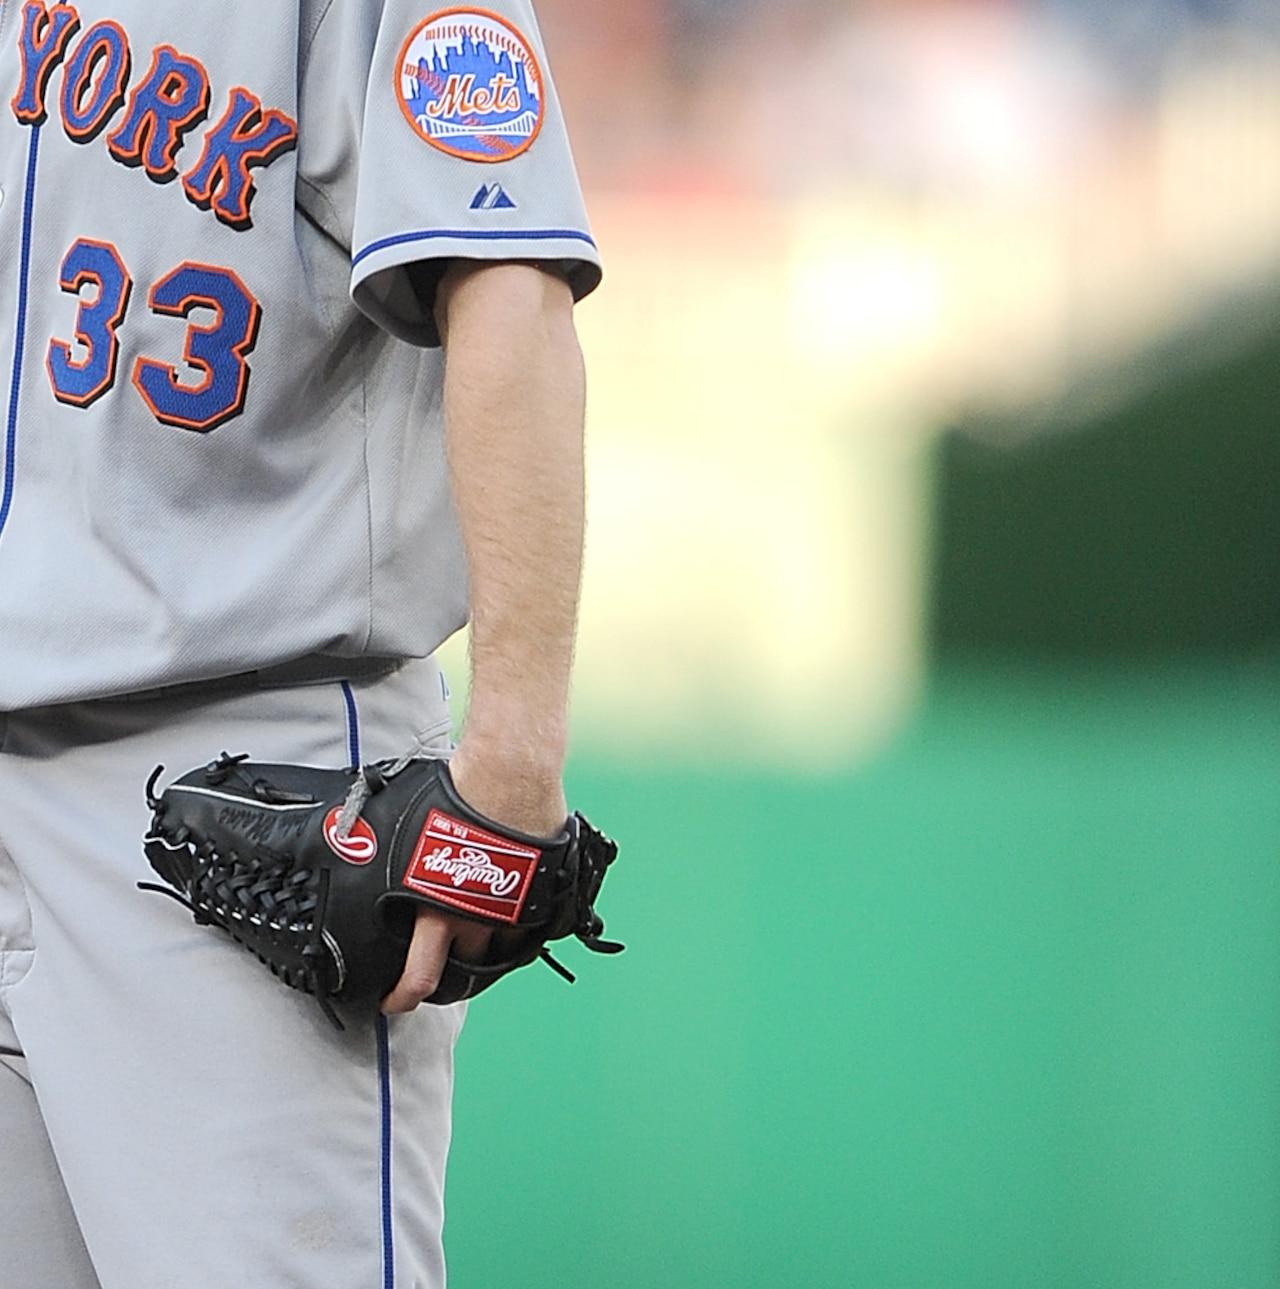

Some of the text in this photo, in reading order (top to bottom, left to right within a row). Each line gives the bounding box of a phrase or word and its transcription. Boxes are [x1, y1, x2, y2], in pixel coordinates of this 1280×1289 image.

[425, 73, 522, 119] Mets
[45, 237, 263, 434] 33
[422, 846, 521, 896] Rawlings
